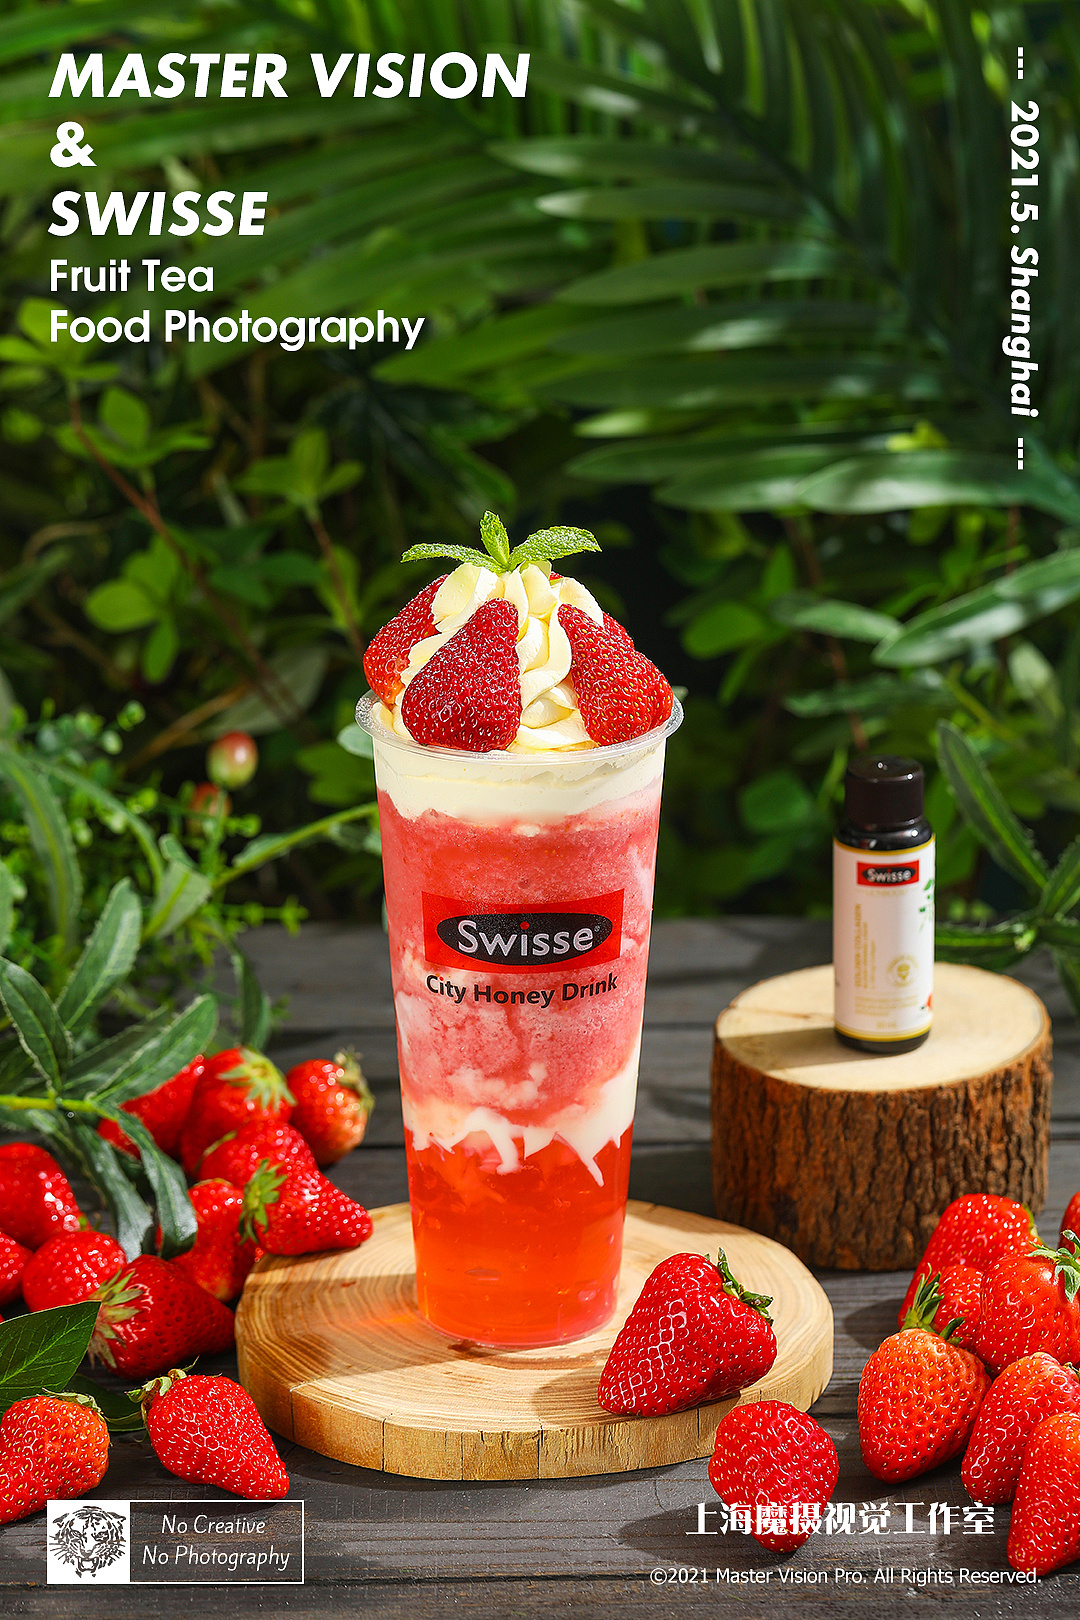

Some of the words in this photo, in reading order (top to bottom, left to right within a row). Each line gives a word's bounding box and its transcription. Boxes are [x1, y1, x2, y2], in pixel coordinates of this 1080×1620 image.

[867, 868, 911, 883] Swisse
[457, 919, 594, 956] Swisse
[426, 975, 466, 1003] City
[474, 985, 555, 1008] Honey
[562, 973, 617, 1001] Drink
